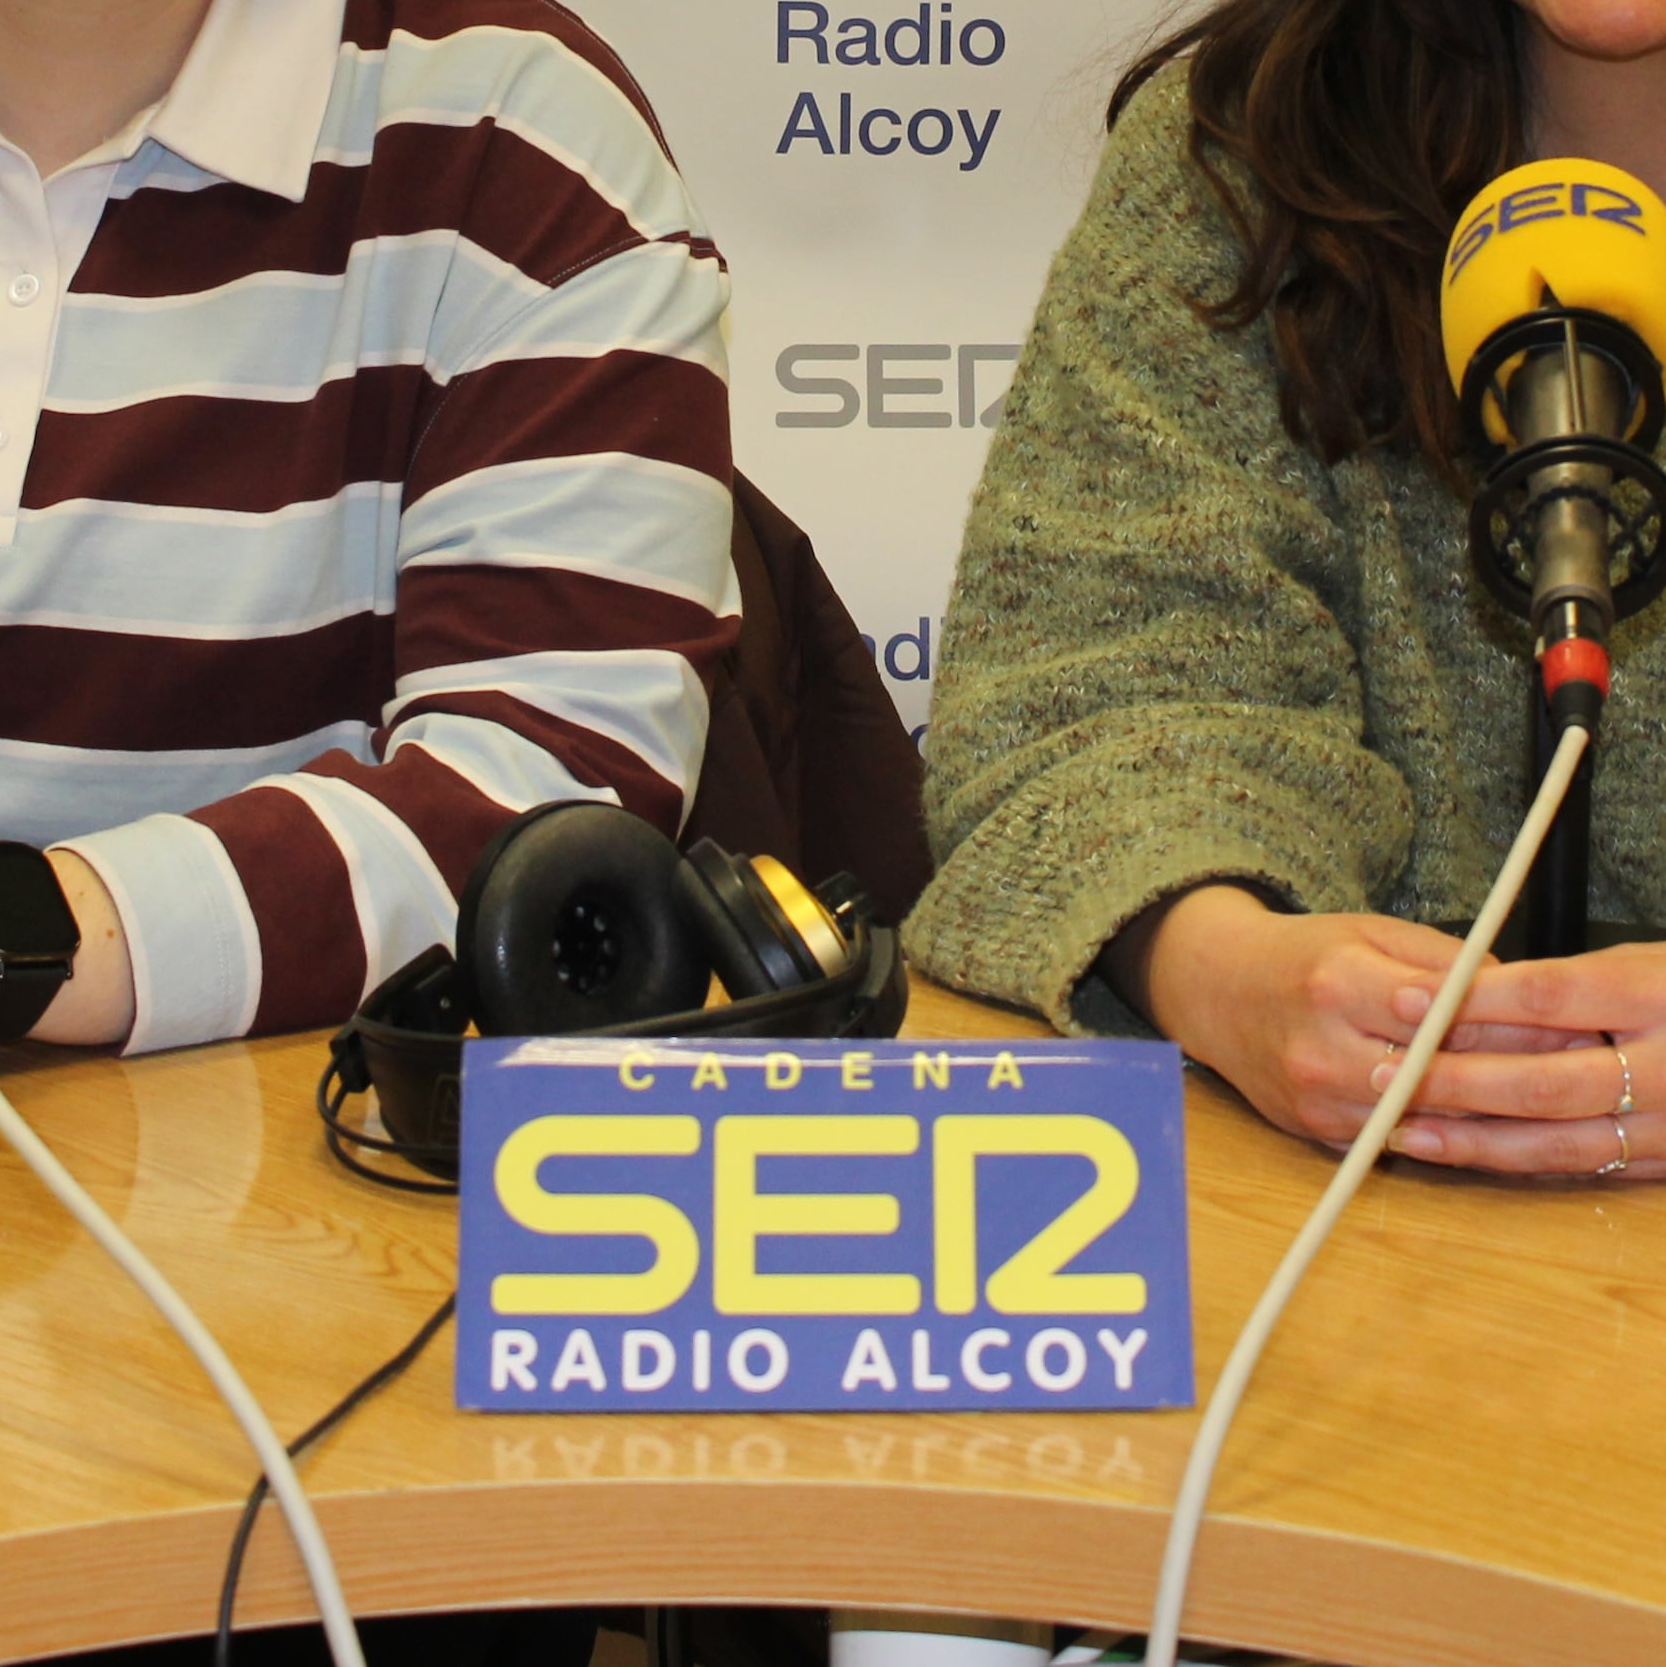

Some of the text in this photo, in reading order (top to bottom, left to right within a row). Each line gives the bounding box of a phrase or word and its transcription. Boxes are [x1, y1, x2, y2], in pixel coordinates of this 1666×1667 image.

[777, 1, 1006, 66] Radio
[776, 92, 1001, 172] Alcoy
[1449, 183, 1646, 286] SER
[618, 1050, 1024, 1091] CADENA
[490, 1114, 1147, 1315] SER
[490, 1327, 1148, 1392] RADIO ALCOY
